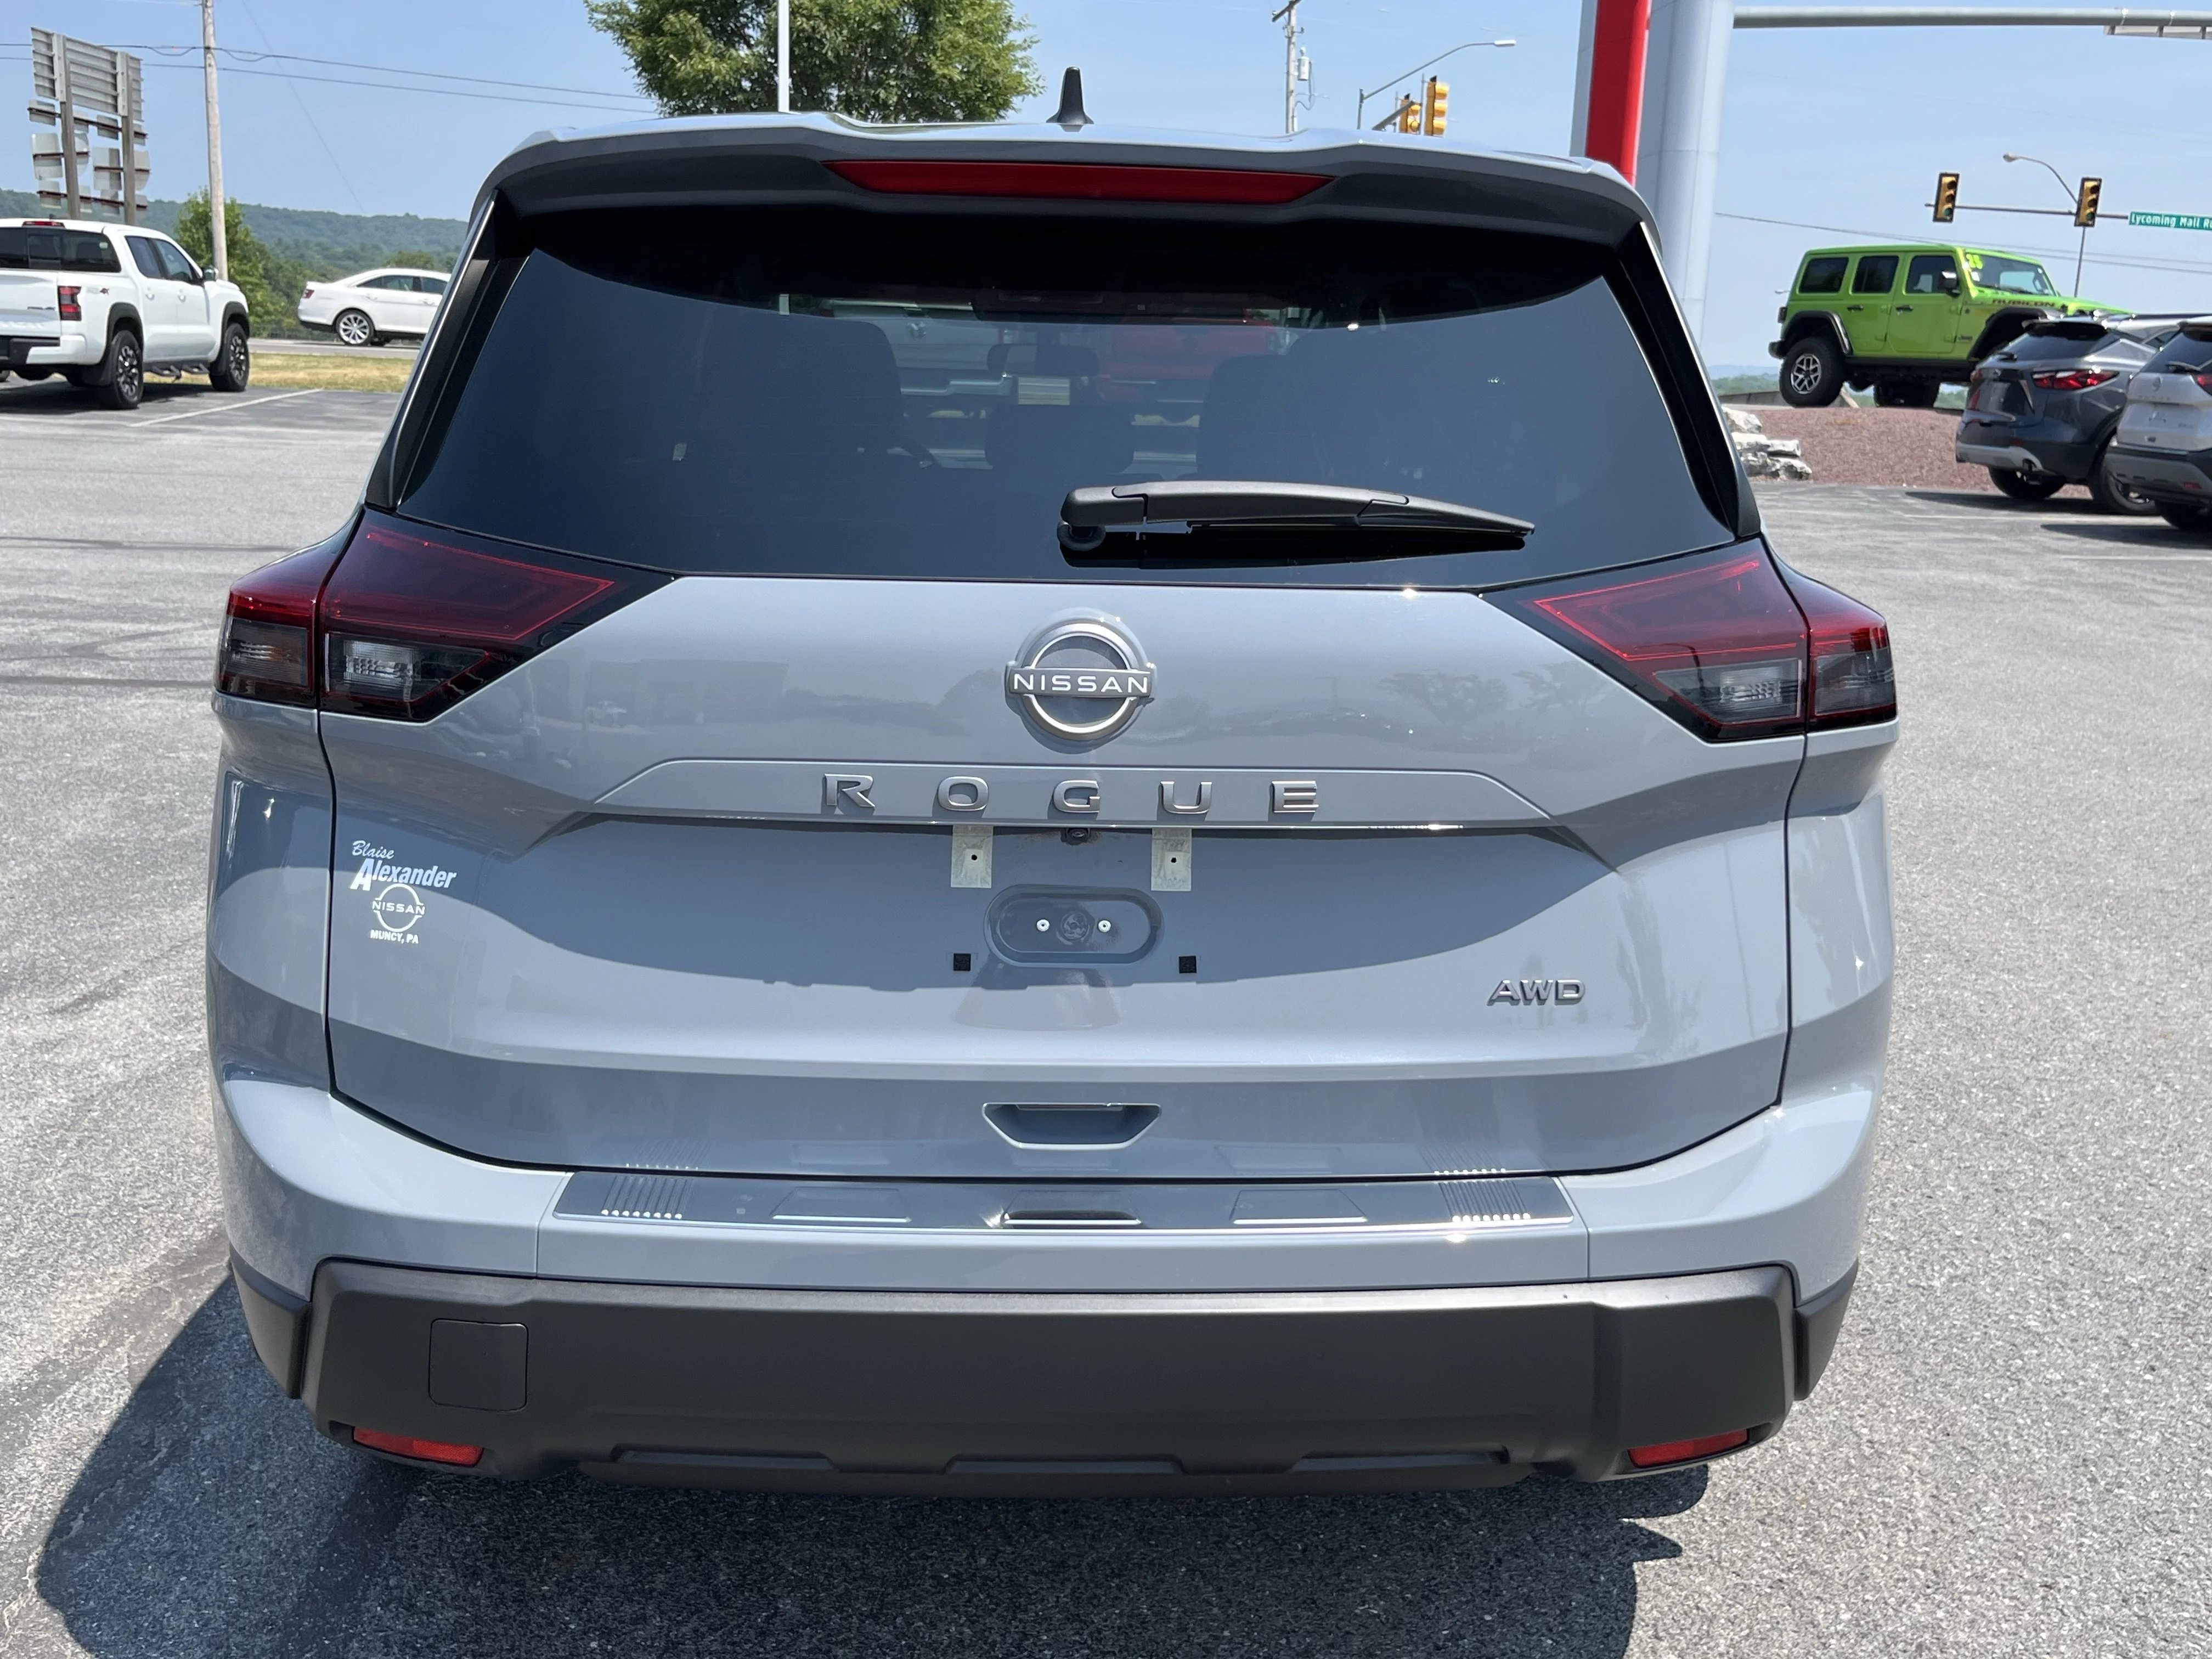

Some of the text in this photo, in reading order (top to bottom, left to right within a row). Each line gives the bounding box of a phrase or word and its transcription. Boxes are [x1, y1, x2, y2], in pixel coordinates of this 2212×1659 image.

[2131, 213, 2176, 227] Lycoming
[2180, 217, 2200, 228] Mall
[1014, 674, 1148, 693] NISSAN
[826, 774, 1318, 814] ROGUE
[352, 840, 395, 860] Blaise
[349, 857, 457, 891] Alexander
[372, 901, 425, 915] NISSAN
[370, 929, 419, 944] MUNCY, PA
[1486, 979, 1586, 1006] AWD
